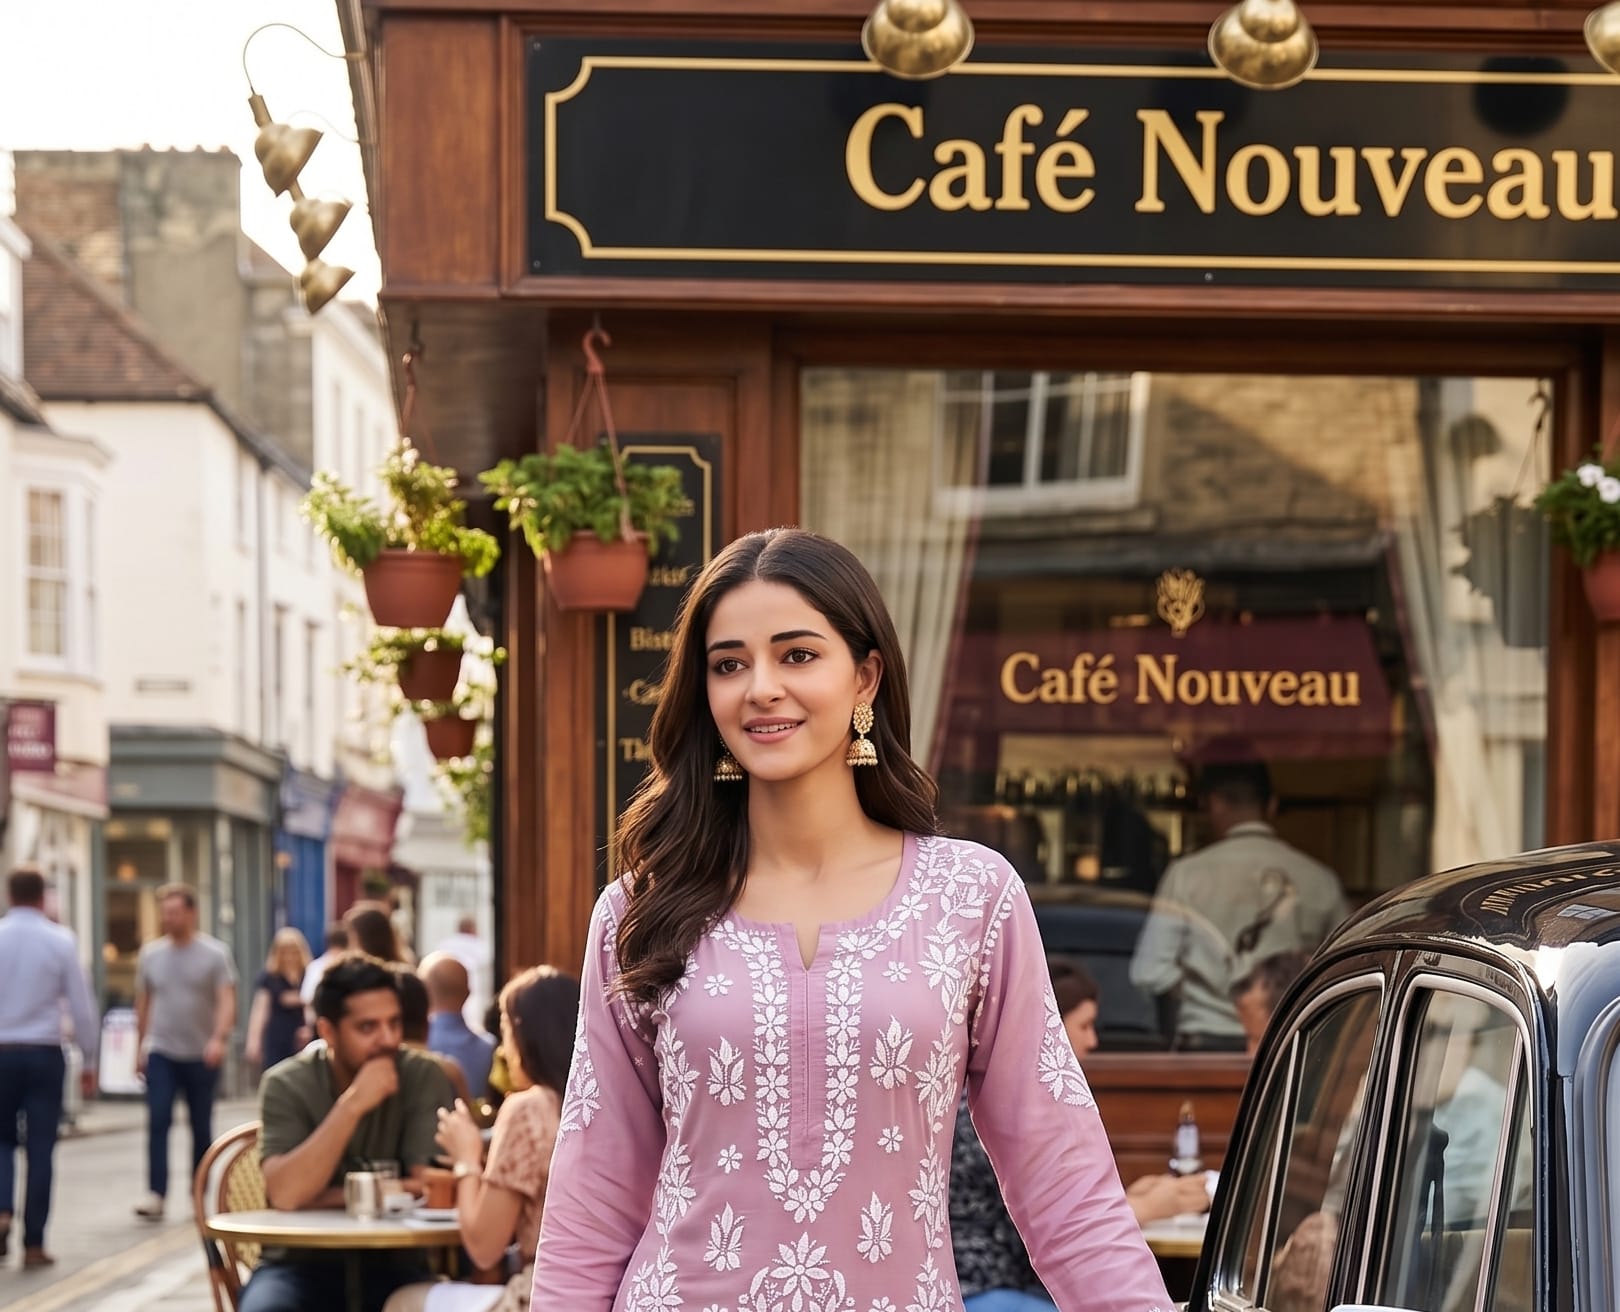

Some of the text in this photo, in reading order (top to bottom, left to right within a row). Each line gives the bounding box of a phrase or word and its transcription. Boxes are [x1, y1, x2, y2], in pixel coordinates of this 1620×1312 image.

[845, 103, 1619, 221] Café Nouveau
[629, 626, 676, 650] Bist
[1000, 651, 1361, 706] Café Nouveau
